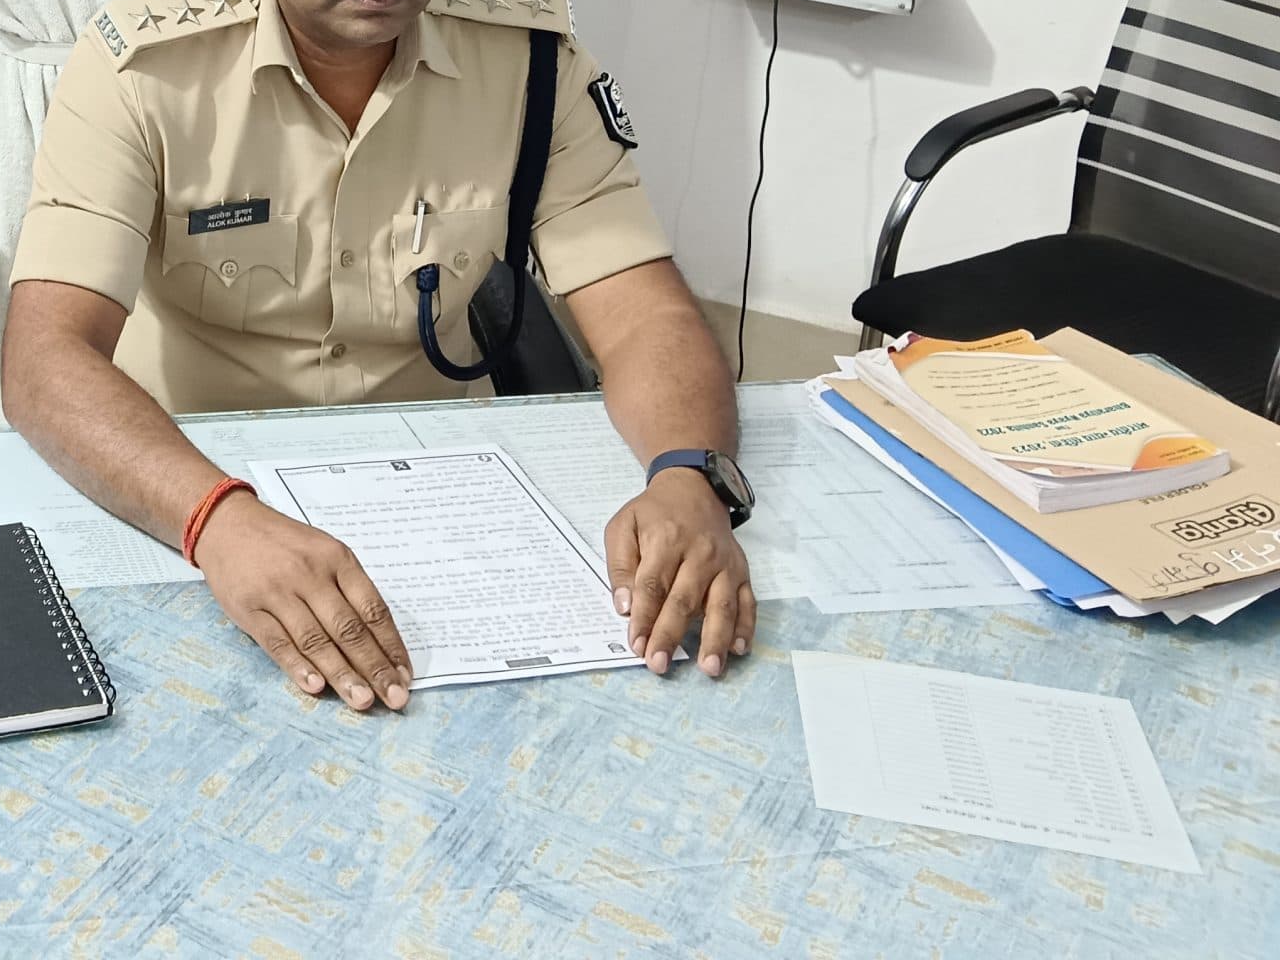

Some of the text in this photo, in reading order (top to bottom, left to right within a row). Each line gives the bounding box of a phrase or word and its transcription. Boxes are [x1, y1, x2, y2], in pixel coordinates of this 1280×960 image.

[207, 216, 253, 228] ALOK KUMAR
[1166, 481, 1209, 498] FOLDER
